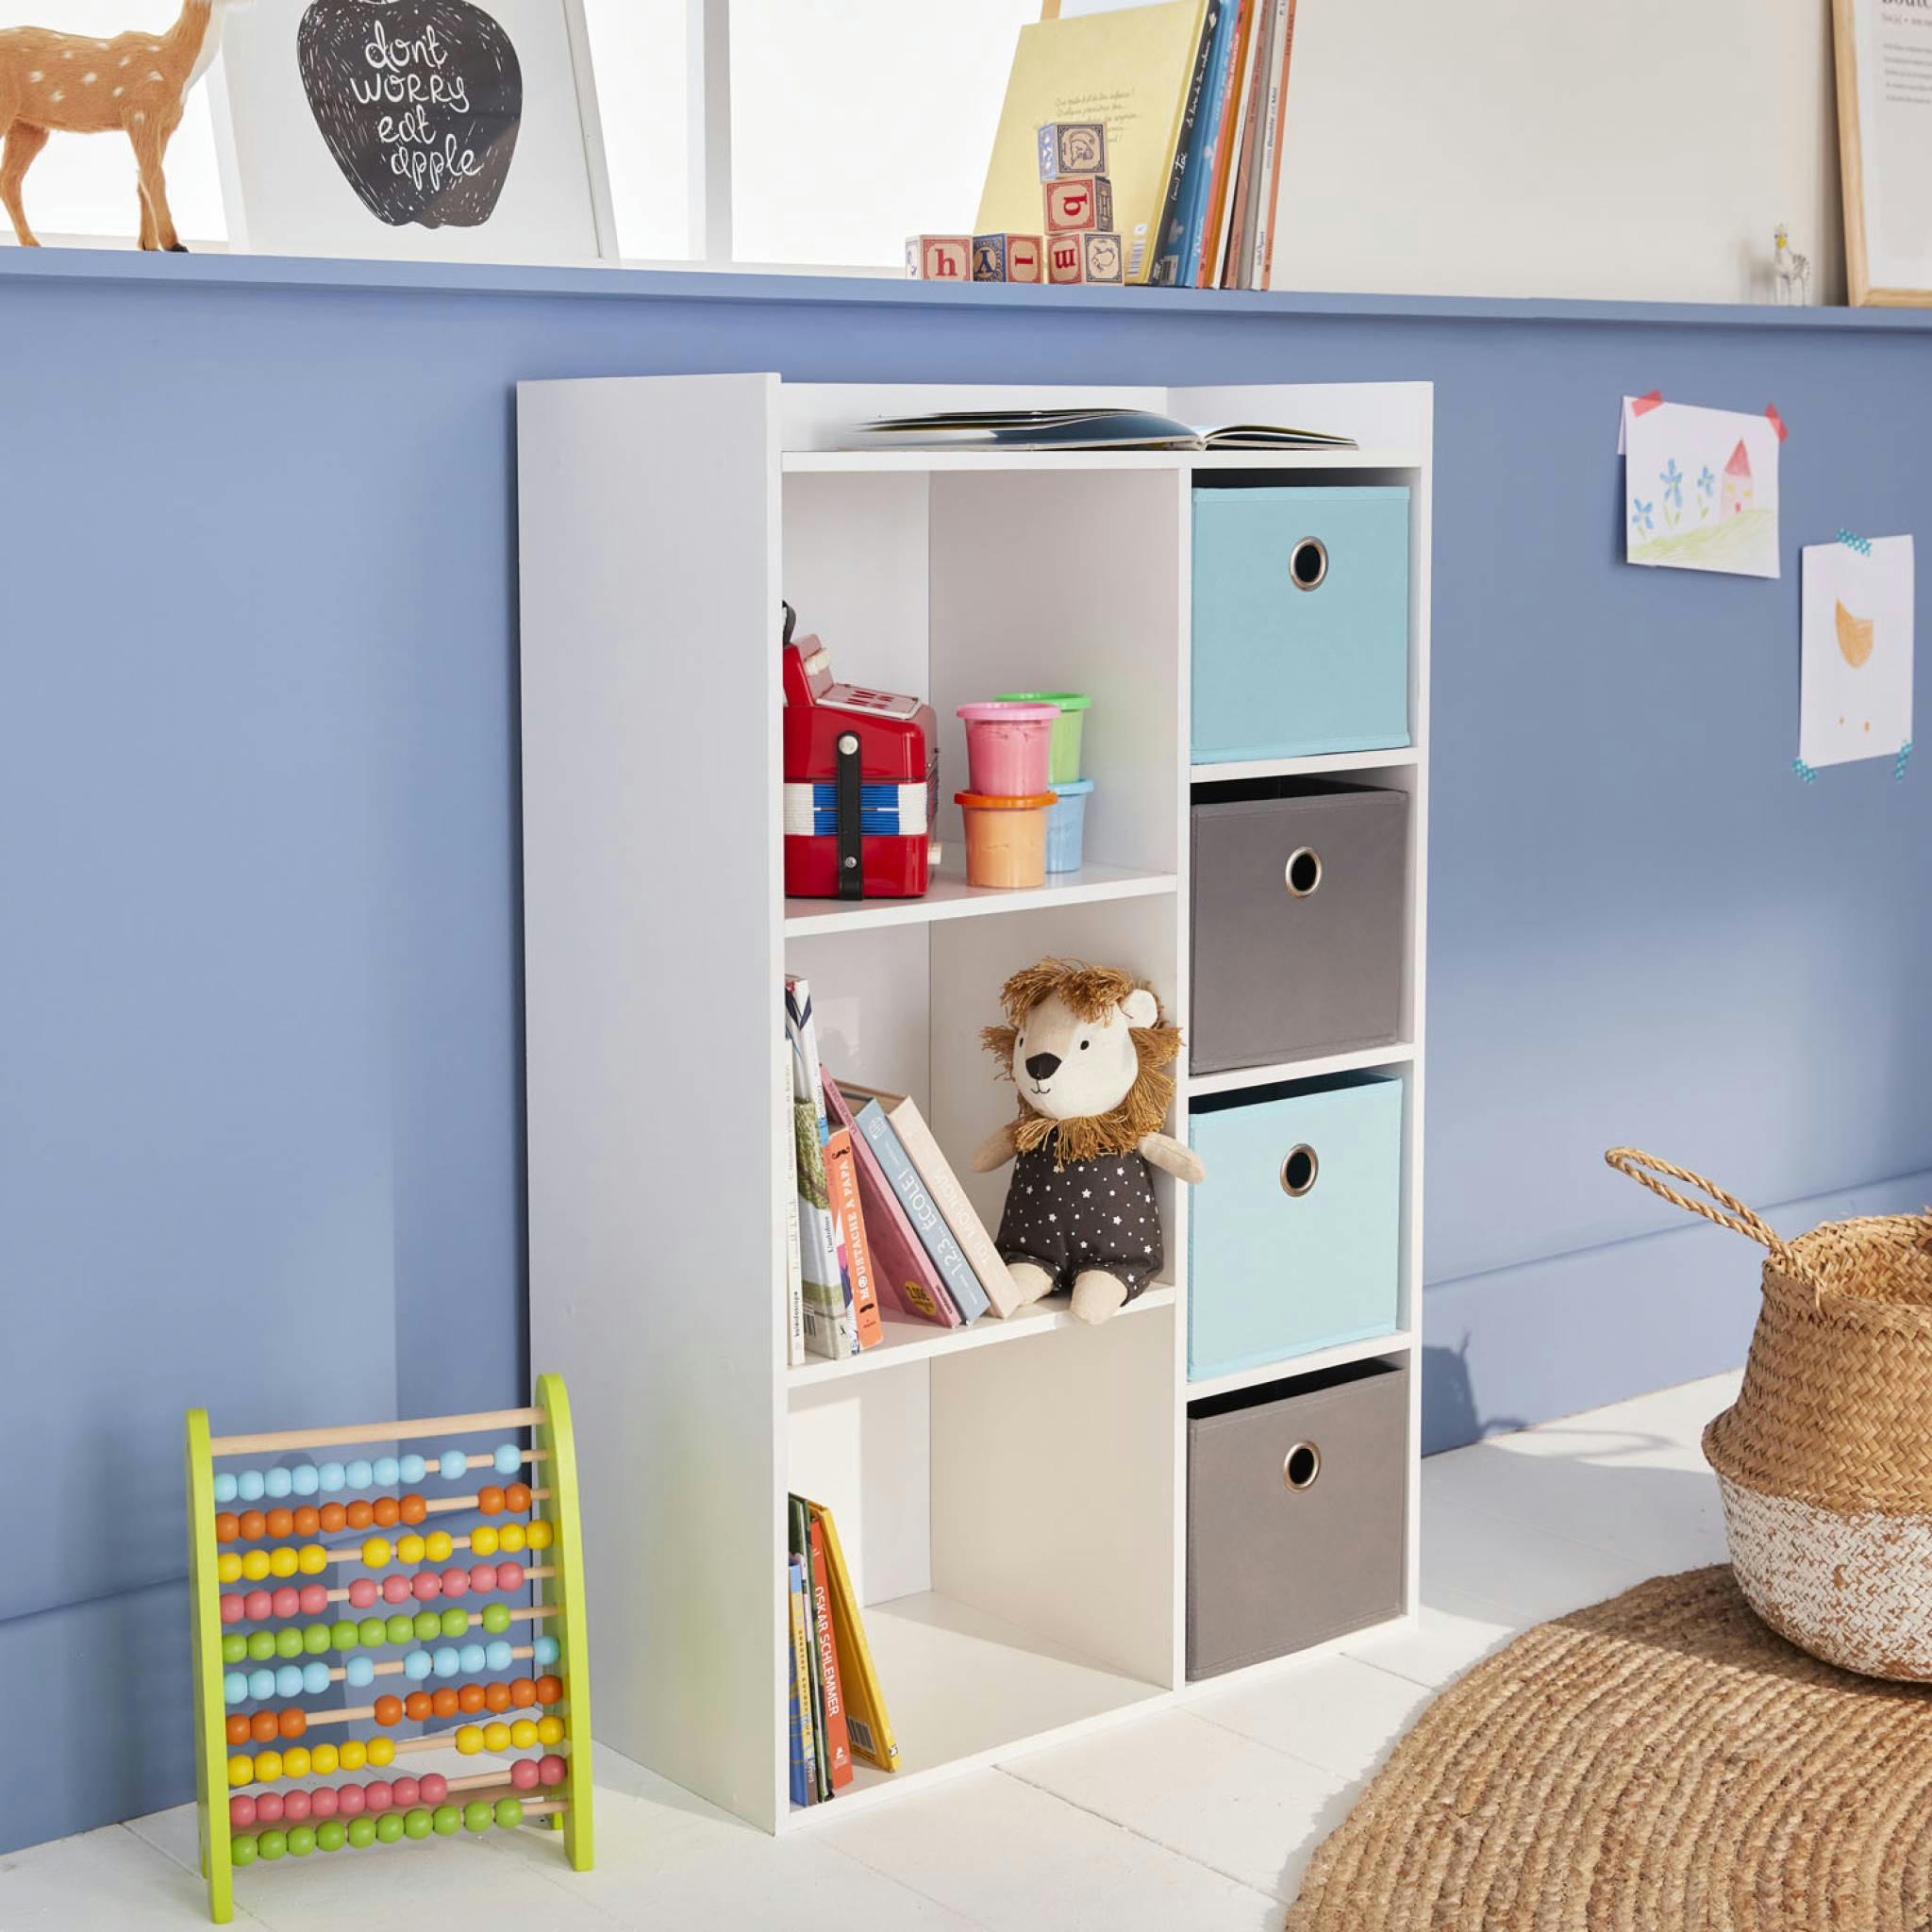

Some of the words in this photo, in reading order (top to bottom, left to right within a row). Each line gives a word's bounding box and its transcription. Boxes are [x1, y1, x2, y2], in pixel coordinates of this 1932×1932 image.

[378, 104, 437, 144] eat
[391, 133, 484, 191] apple
[935, 248, 958, 275] h
[840, 1161, 853, 1196] PAPA
[847, 1211, 871, 1300] MOUSTACHE
[815, 1586, 829, 1632] OSKAR
[820, 1633, 840, 1717] SCHLEMMER
